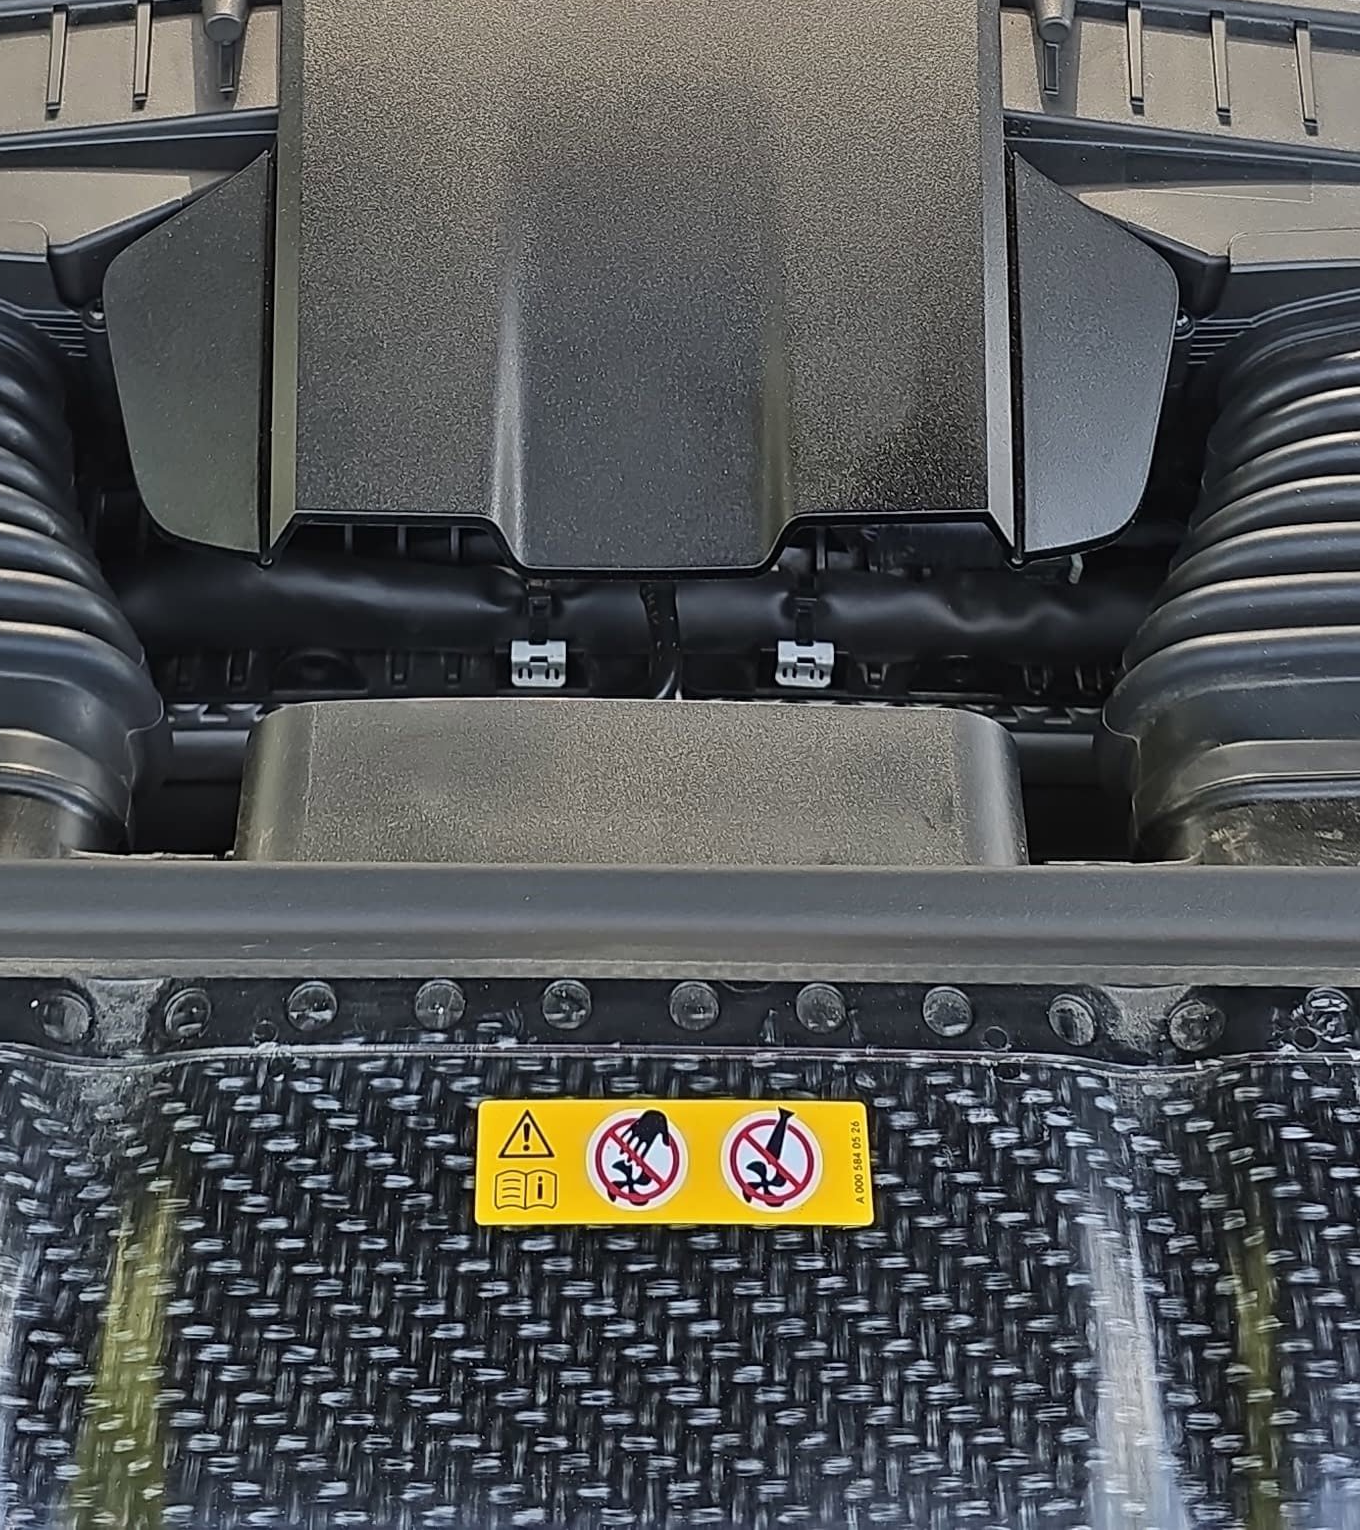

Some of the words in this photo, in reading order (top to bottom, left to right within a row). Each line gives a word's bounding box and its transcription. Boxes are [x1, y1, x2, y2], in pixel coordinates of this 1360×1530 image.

[850, 1121, 860, 1133] 26
[851, 1137, 861, 1149] 05
[852, 1153, 863, 1171] 584
[854, 1174, 864, 1193] 000
